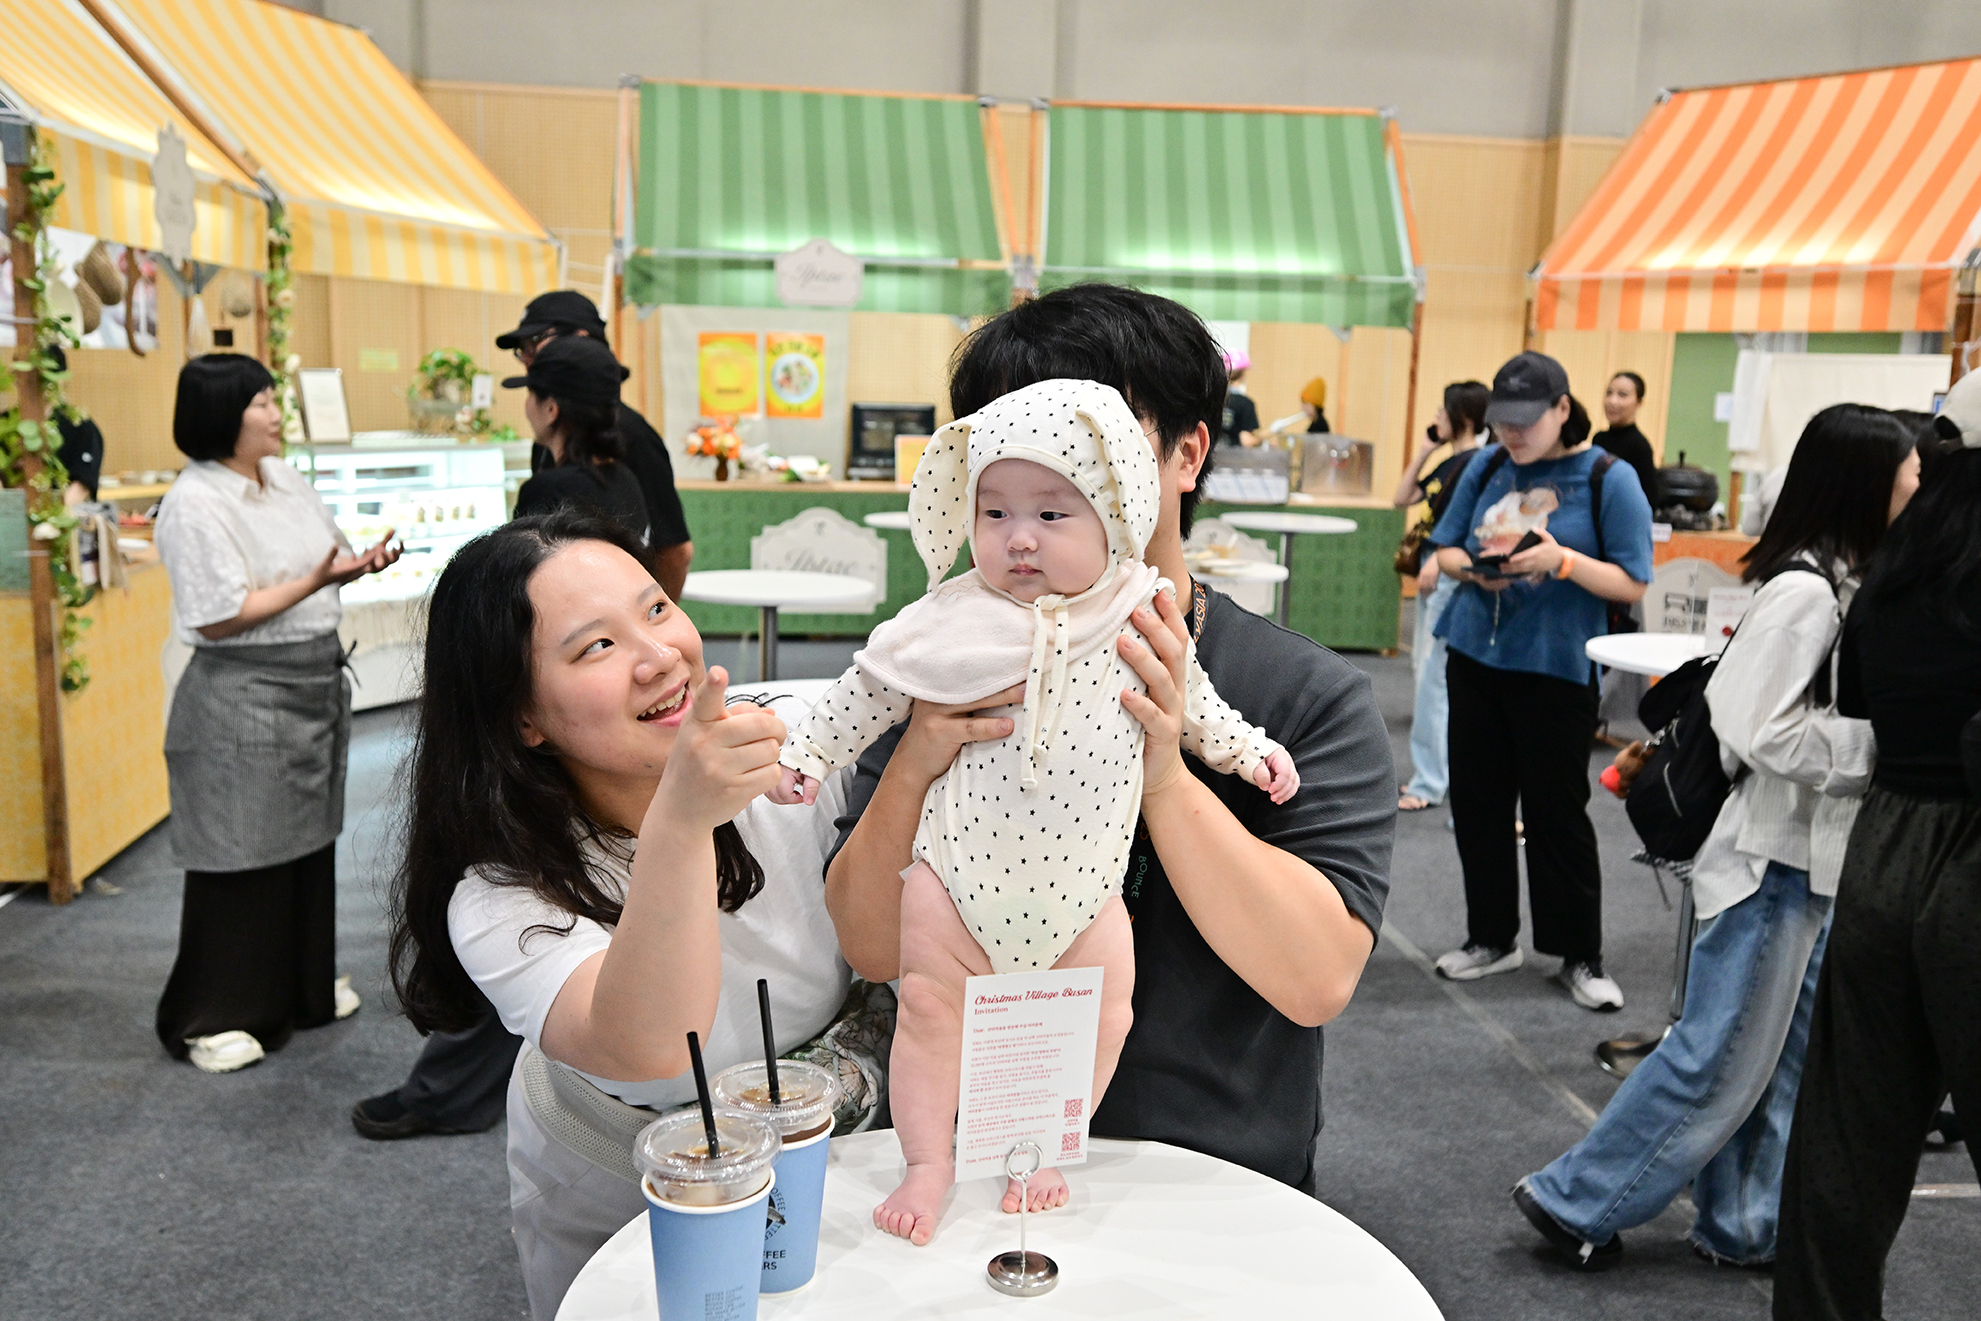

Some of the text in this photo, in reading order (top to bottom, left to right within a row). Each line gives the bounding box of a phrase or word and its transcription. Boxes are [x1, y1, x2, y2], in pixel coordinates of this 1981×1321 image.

[1131, 855, 1148, 899] BOUNCE
[974, 987, 1093, 1006] Christmas Village Busan
[974, 1006, 1008, 1016] Invitation
[771, 1187, 786, 1211] OFFEE
[763, 1249, 786, 1259] FEE
[762, 1261, 777, 1270] RS
